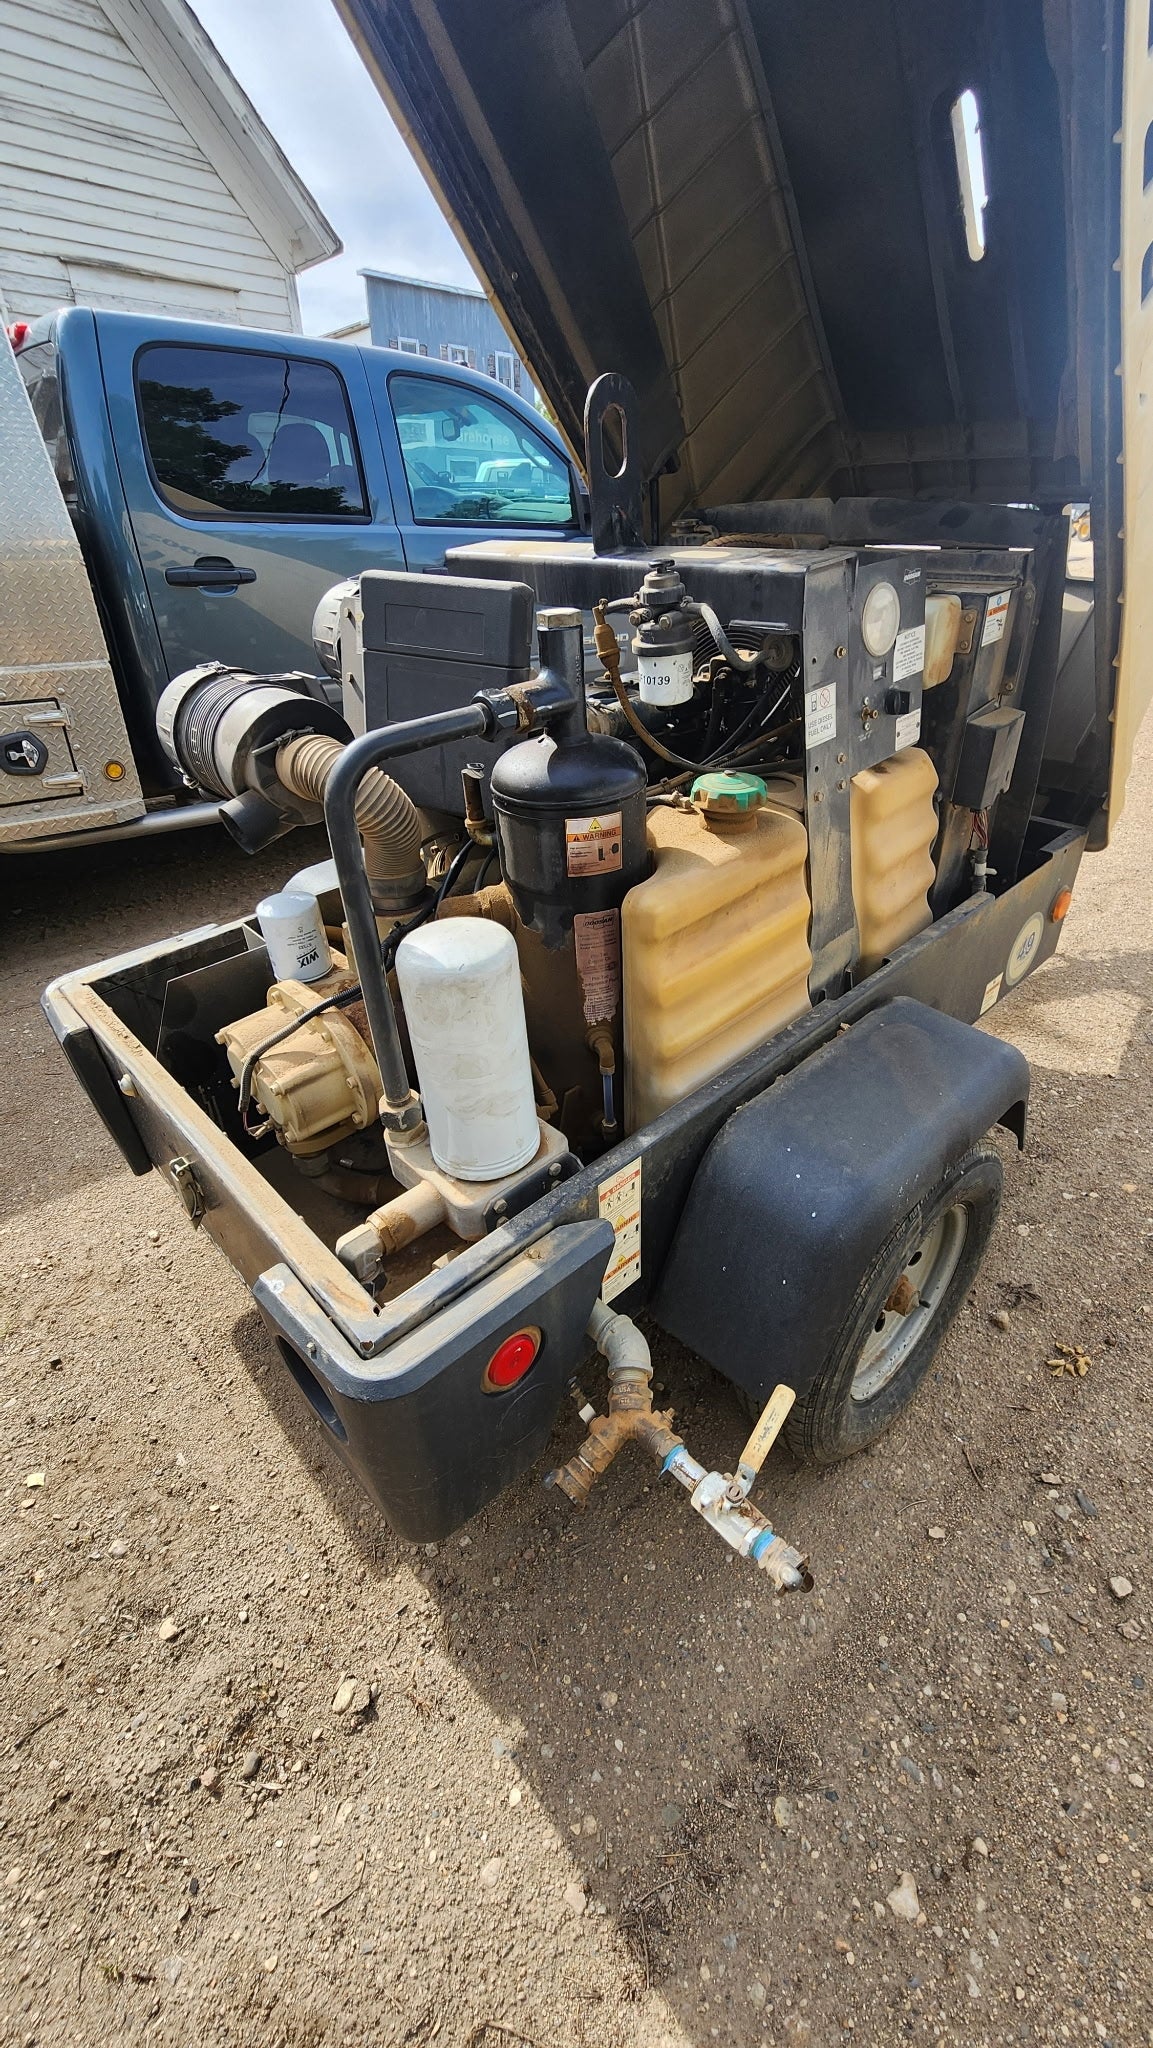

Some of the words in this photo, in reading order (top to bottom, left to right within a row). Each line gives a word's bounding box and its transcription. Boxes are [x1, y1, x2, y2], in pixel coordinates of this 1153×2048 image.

[640, 674, 671, 686] 10139
[808, 719, 818, 729] USE
[818, 714, 833, 725] DIESEL
[808, 728, 820, 737] FUEL
[820, 722, 833, 733] ONLY
[582, 829, 617, 840] WARNING
[297, 951, 319, 968] WIX
